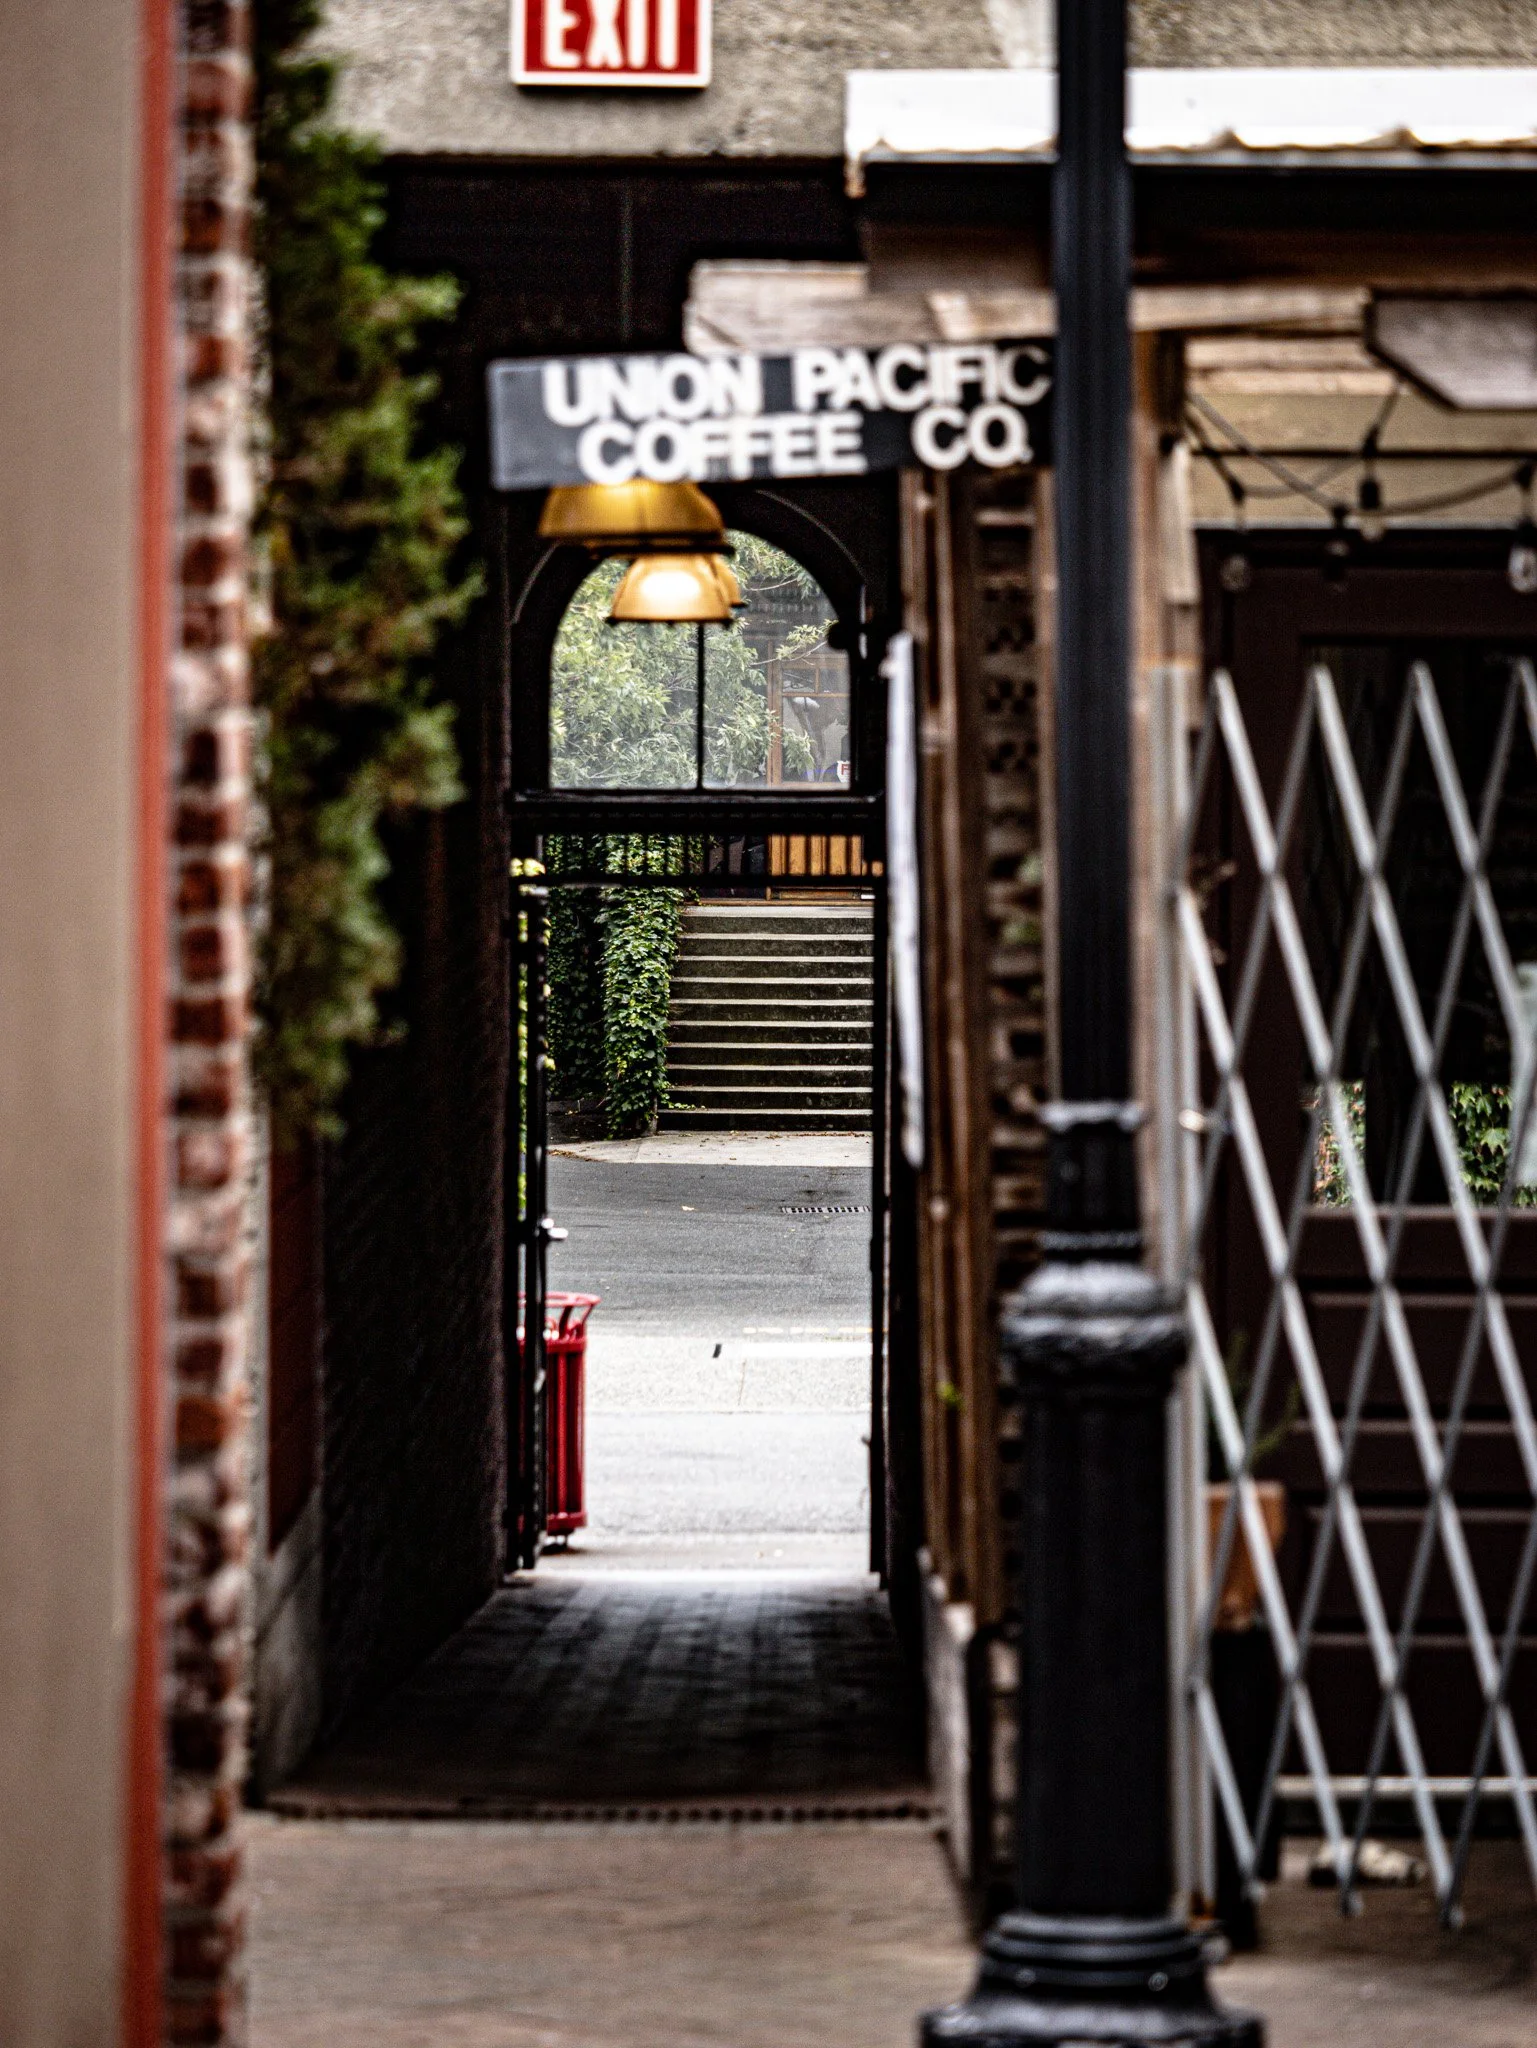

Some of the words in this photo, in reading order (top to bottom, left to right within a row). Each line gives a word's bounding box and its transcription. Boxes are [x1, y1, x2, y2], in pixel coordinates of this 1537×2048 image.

[543, 353, 764, 427] UNION
[791, 343, 1050, 411] PACIFIC
[577, 412, 868, 485] COFFEE
